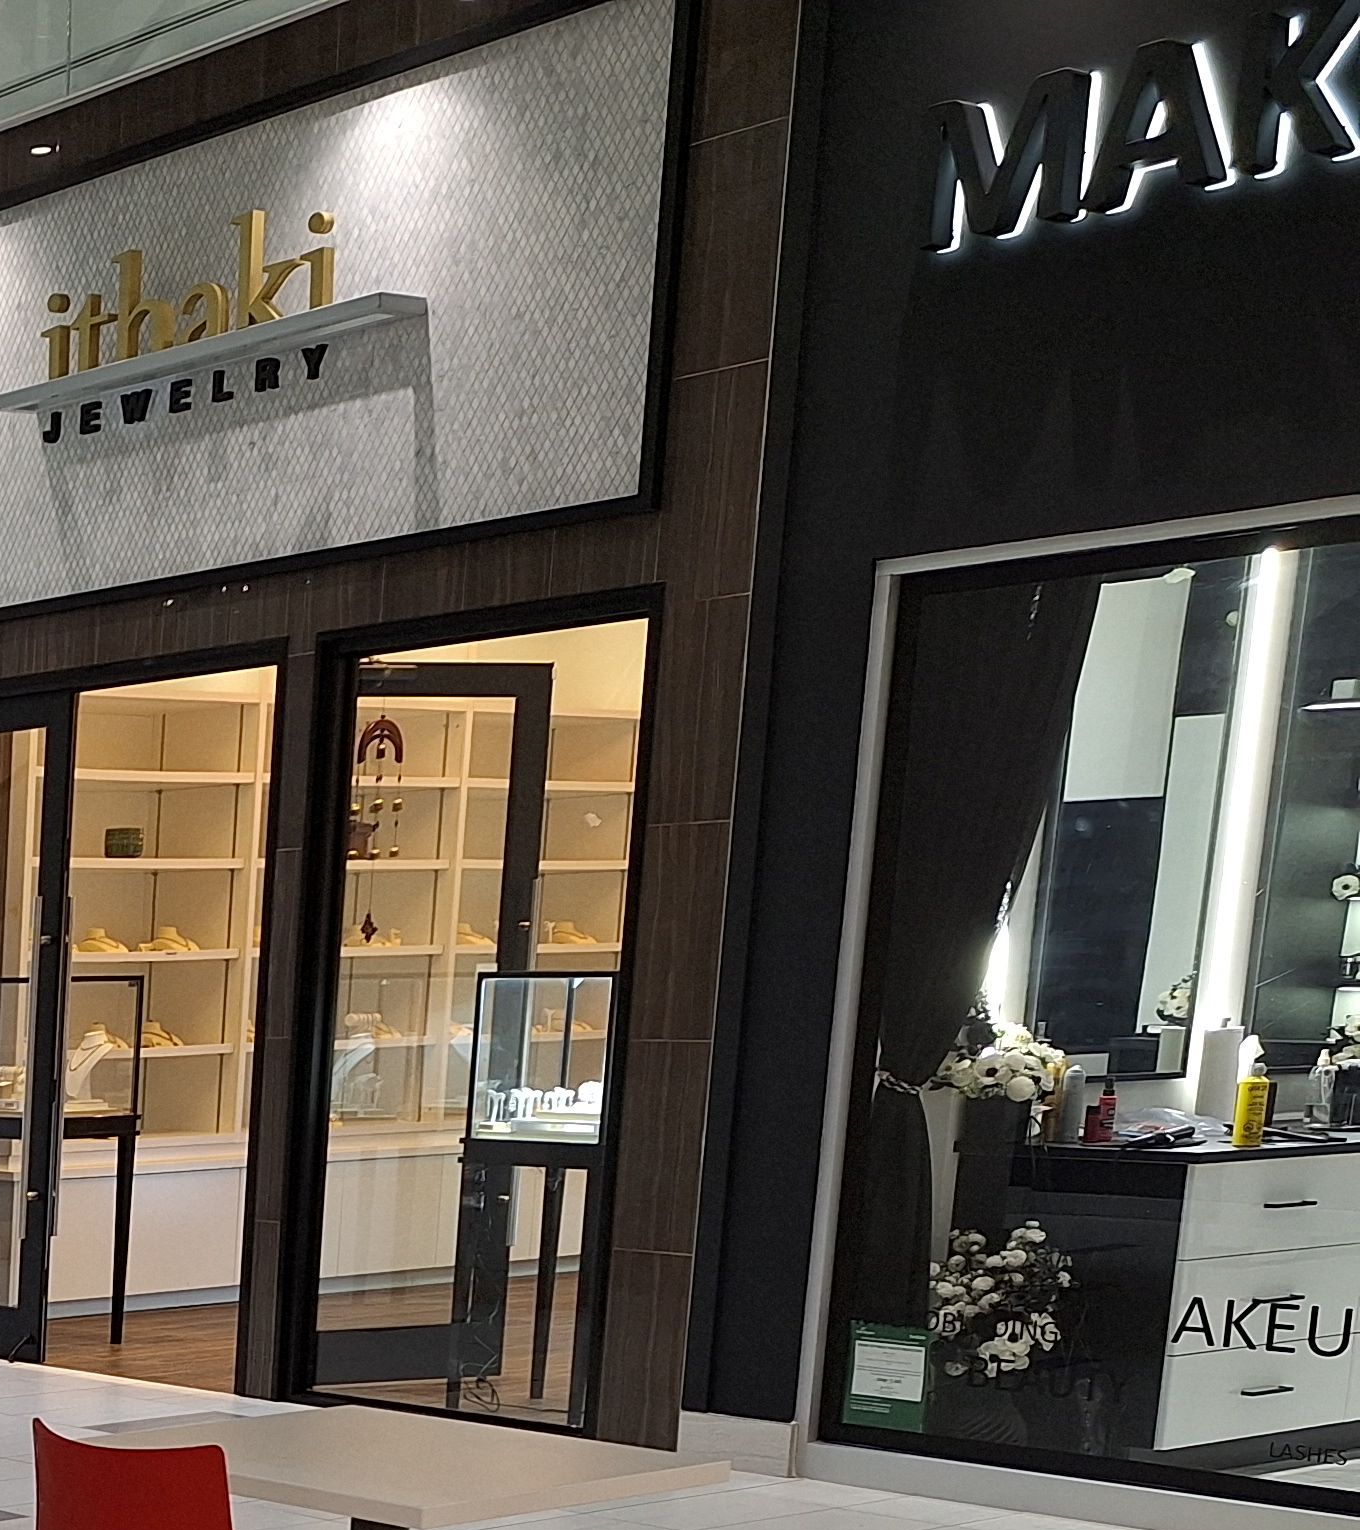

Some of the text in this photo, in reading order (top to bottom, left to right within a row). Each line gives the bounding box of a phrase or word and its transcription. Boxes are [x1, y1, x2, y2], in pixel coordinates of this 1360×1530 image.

[922, 0, 1360, 254] MAK
[41, 209, 335, 380] ithaki
[42, 343, 329, 444] JEWELRY
[1269, 1441, 1348, 1465] LASHES
